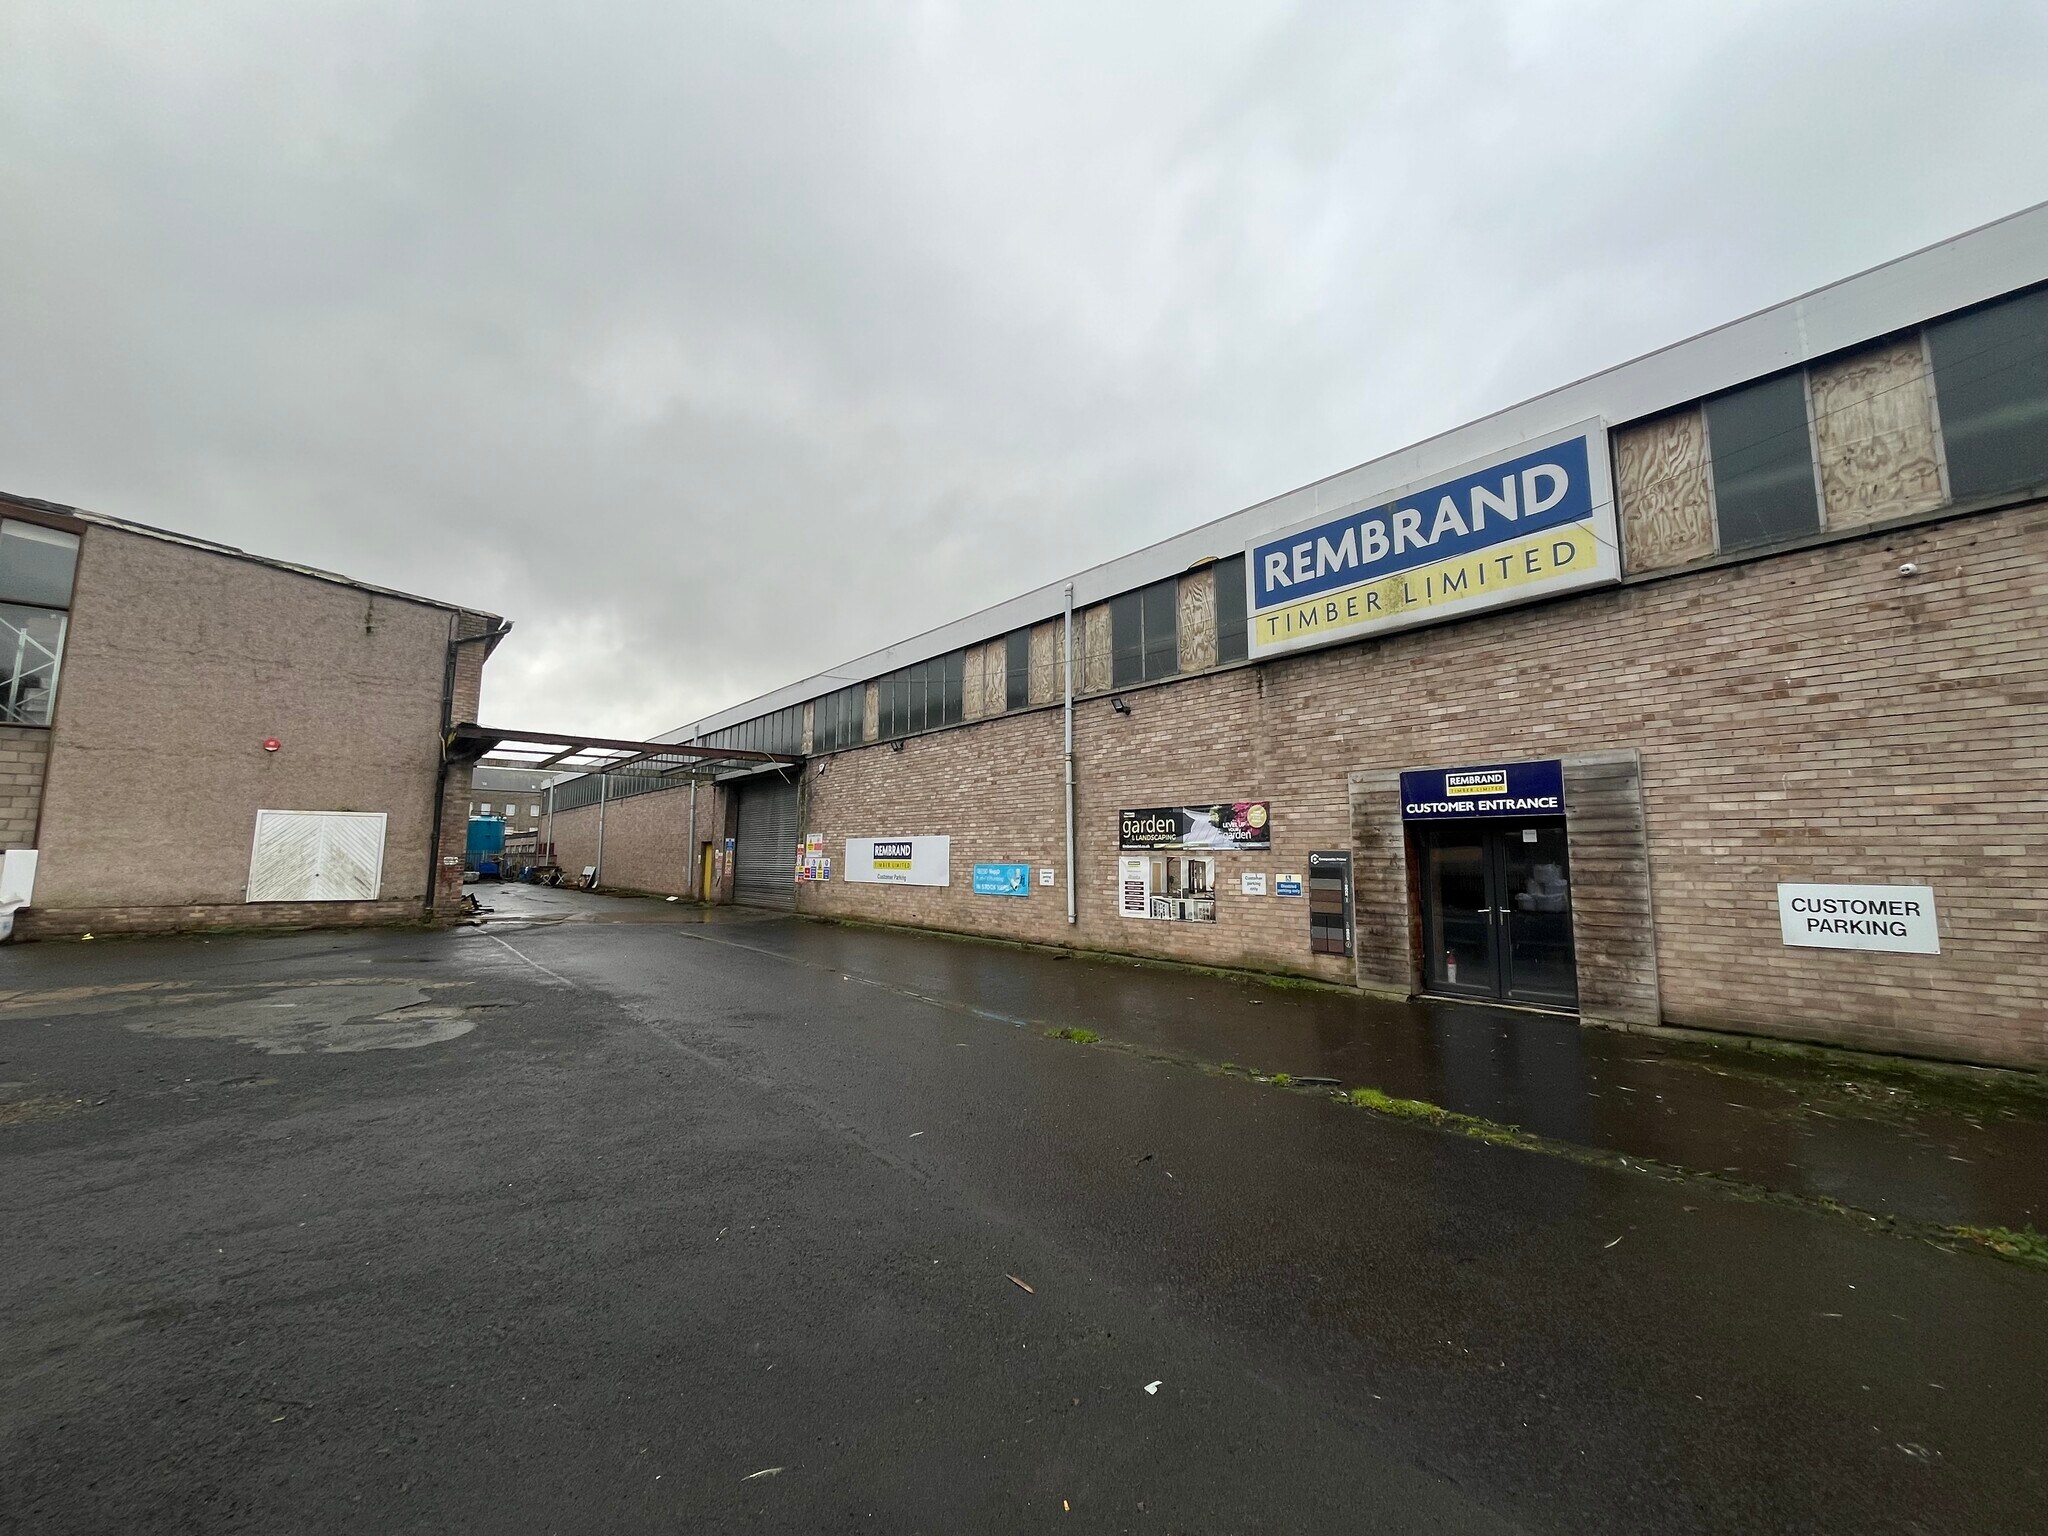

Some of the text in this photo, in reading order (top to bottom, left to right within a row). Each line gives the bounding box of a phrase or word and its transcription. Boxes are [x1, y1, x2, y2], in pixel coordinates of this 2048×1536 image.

[1264, 463, 1569, 592] REMBRAND
[1267, 541, 1577, 636] TIMBER LIMITED
[1450, 774, 1503, 786] REMBRAND
[1406, 797, 1558, 814] CUSTOMER ENTRANCE
[1122, 814, 1176, 839] garden
[1223, 829, 1252, 840] garden
[874, 844, 911, 857] REMBRAND
[1791, 897, 1921, 917] CUSTOMER
[1806, 917, 1908, 937] PARKING
